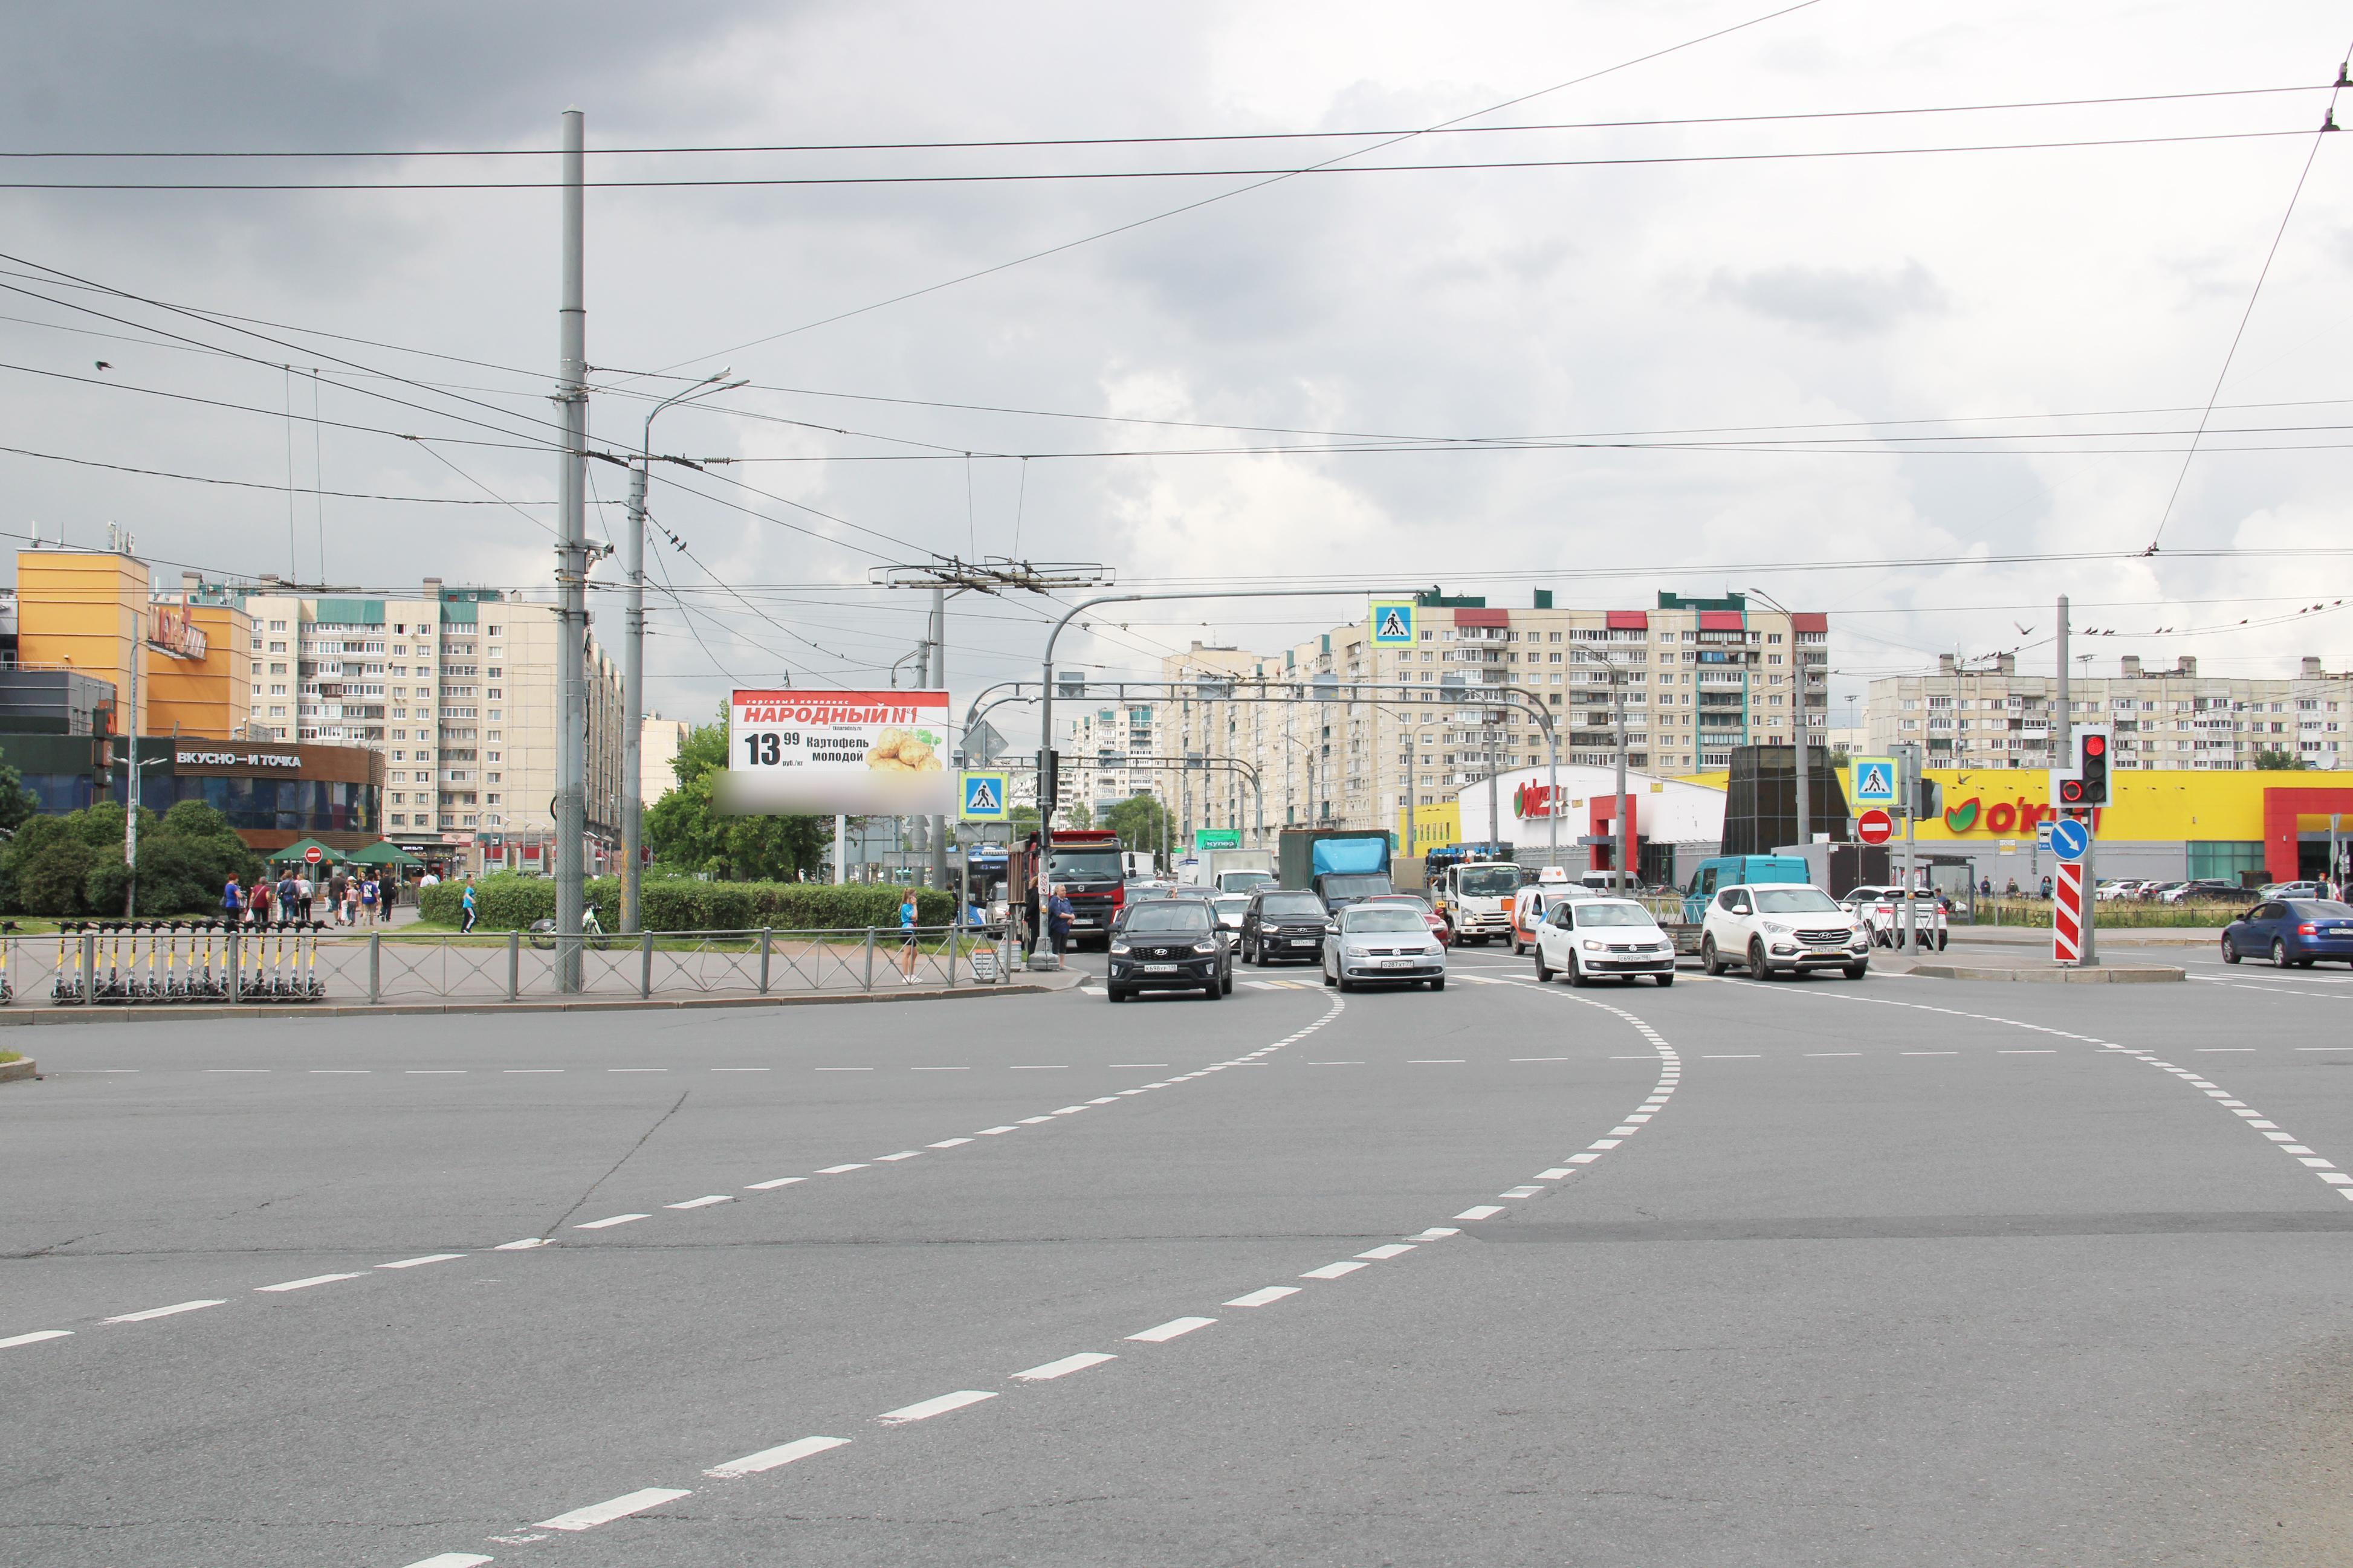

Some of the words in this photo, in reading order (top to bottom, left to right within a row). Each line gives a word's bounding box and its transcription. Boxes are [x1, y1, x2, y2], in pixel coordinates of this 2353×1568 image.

[743, 703, 888, 725] НАРОДНЫЙ
[745, 733, 780, 766] 13
[784, 732, 800, 745] 99
[806, 737, 869, 749] Картофель
[261, 755, 302, 767] ТОЧКА
[812, 750, 863, 763] молодой
